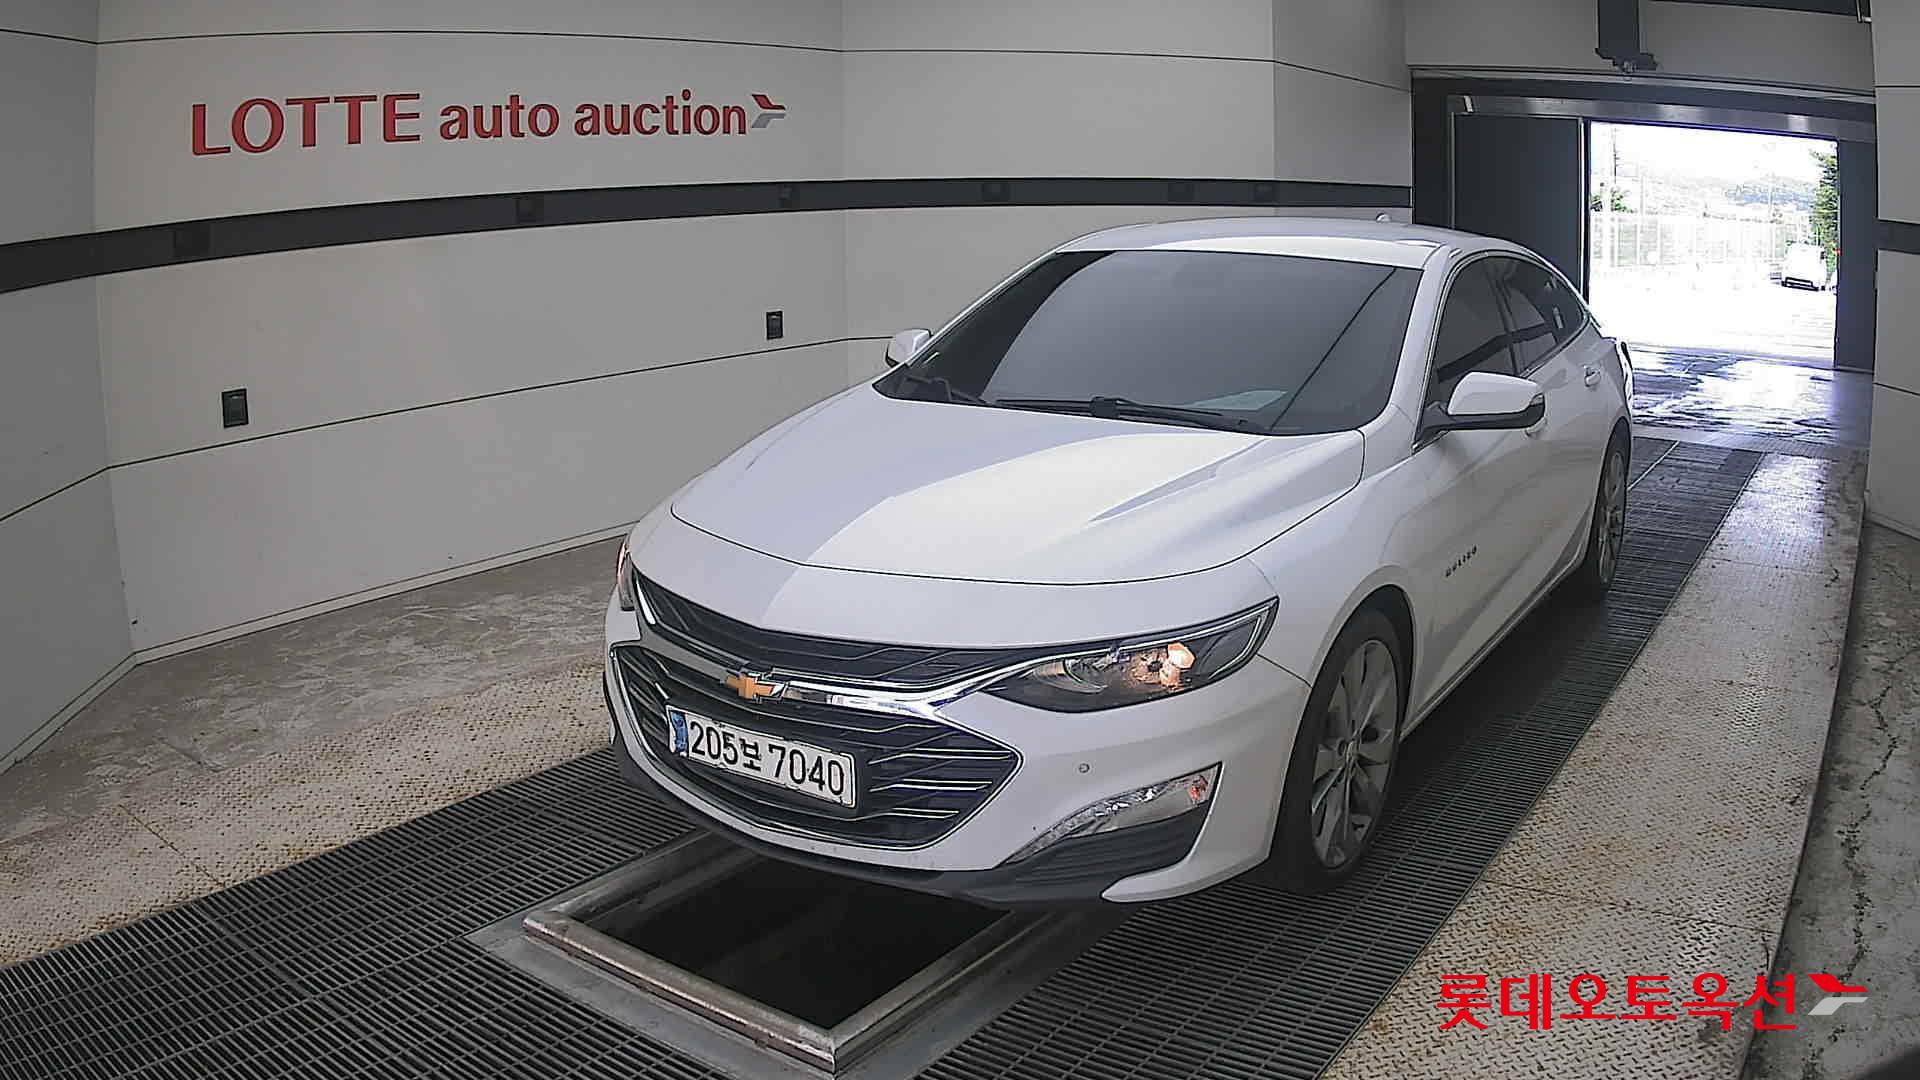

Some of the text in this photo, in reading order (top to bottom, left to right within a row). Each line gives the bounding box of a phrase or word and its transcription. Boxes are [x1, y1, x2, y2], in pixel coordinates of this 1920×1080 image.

[191, 88, 748, 156] LOTTE auto auction
[768, 743, 845, 796] 7040
